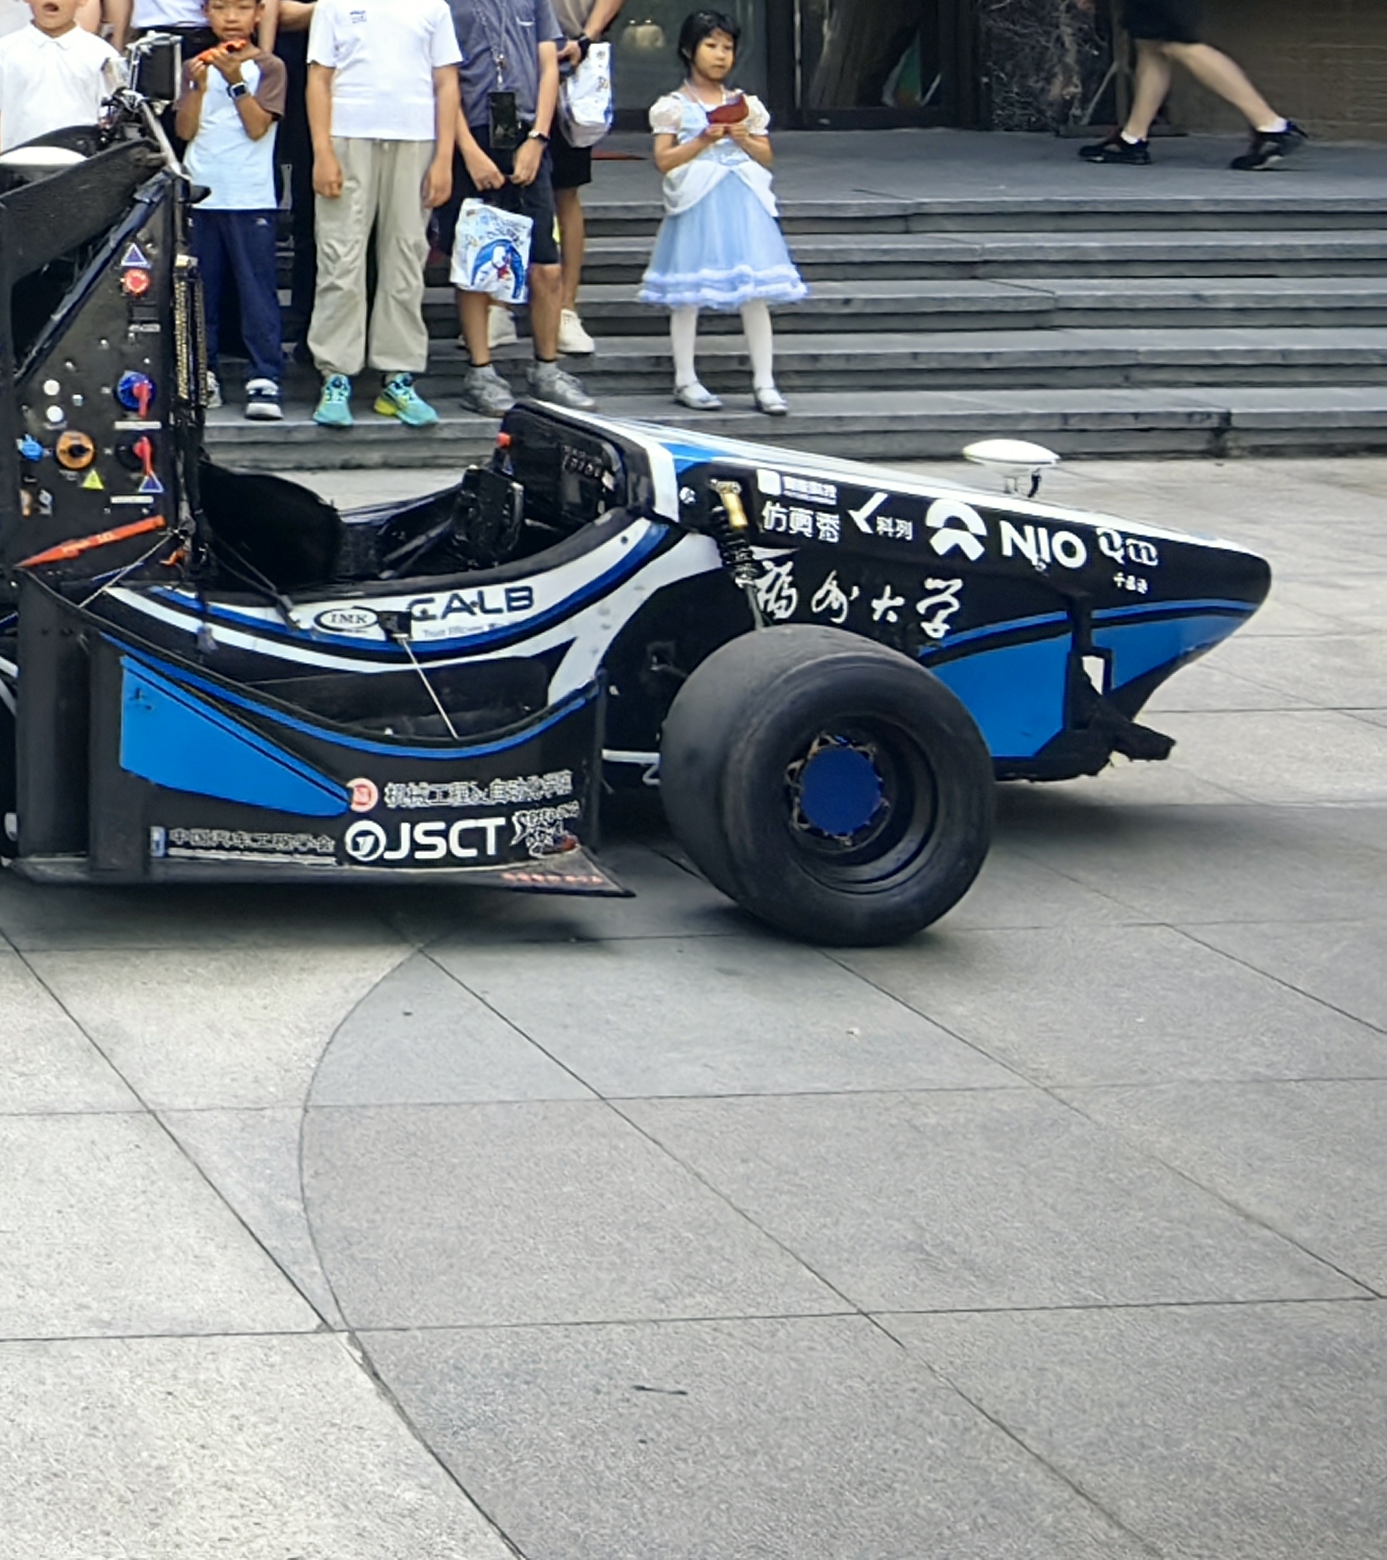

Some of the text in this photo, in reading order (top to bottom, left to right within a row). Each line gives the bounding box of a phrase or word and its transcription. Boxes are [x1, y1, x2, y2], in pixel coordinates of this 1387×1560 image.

[999, 520, 1087, 569] NIO
[407, 586, 535, 622] CALB
[382, 817, 507, 859] JSCT
